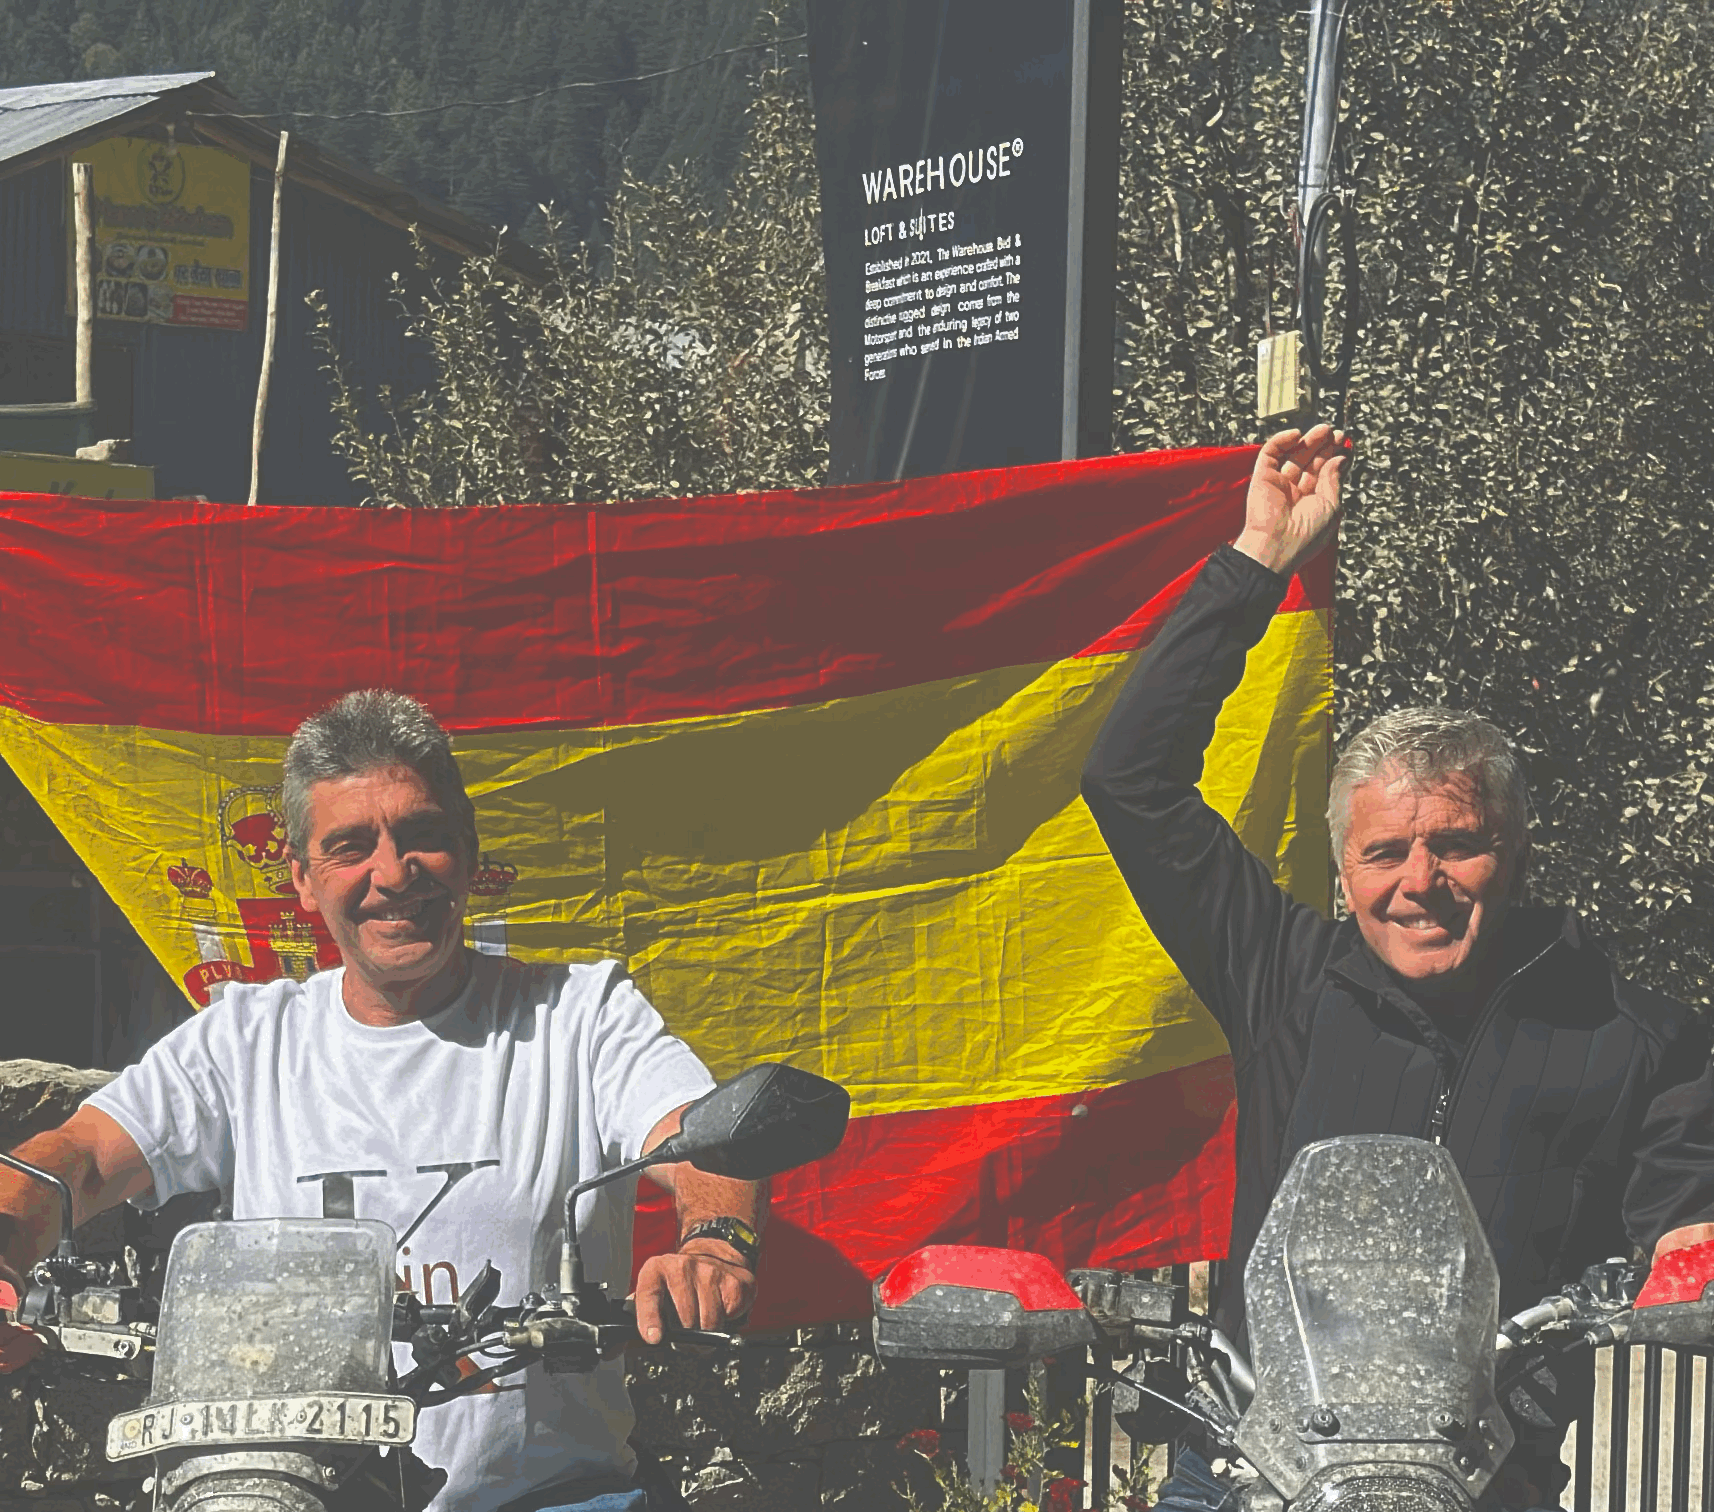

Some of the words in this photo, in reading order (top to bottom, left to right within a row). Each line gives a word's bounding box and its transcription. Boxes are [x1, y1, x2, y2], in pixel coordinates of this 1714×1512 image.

[864, 223, 894, 247] LOFT
[898, 221, 907, 240] &
[909, 211, 955, 241] SUITES
[937, 248, 949, 261] The
[952, 242, 994, 257] Warehouse
[1015, 234, 1021, 247] &
[914, 271, 919, 283] is
[921, 271, 932, 282] an
[935, 264, 974, 281] experience
[999, 254, 1014, 267] with
[1015, 255, 1020, 265] a
[925, 288, 934, 299] to
[960, 279, 977, 293] and
[1006, 272, 1020, 285] The
[1007, 291, 1020, 303] the
[898, 326, 913, 339] and
[918, 324, 931, 336] the
[995, 311, 1002, 324] of
[1005, 311, 1019, 322] two
[899, 344, 917, 356] who
[957, 336, 971, 348] the
